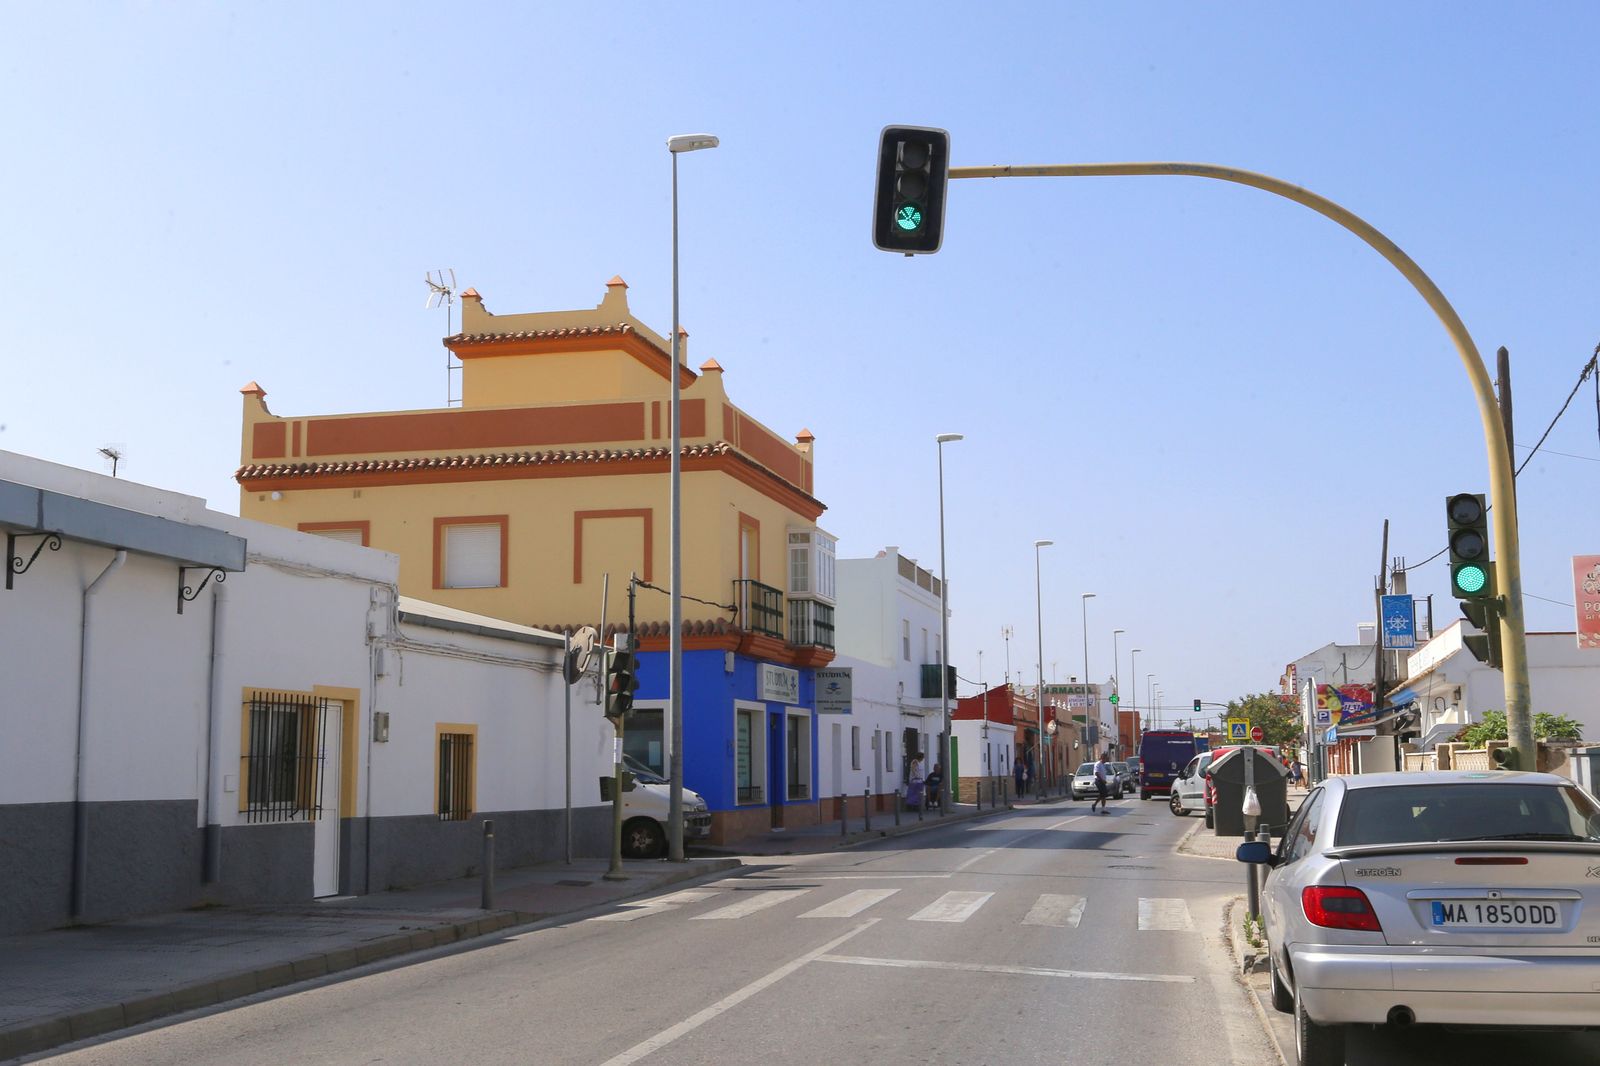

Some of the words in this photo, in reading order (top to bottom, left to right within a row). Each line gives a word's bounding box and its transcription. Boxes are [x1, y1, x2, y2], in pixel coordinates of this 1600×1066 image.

[1319, 712, 1327, 720] P
[1355, 867, 1401, 877] CITROËN
[1441, 903, 1468, 923] MA
